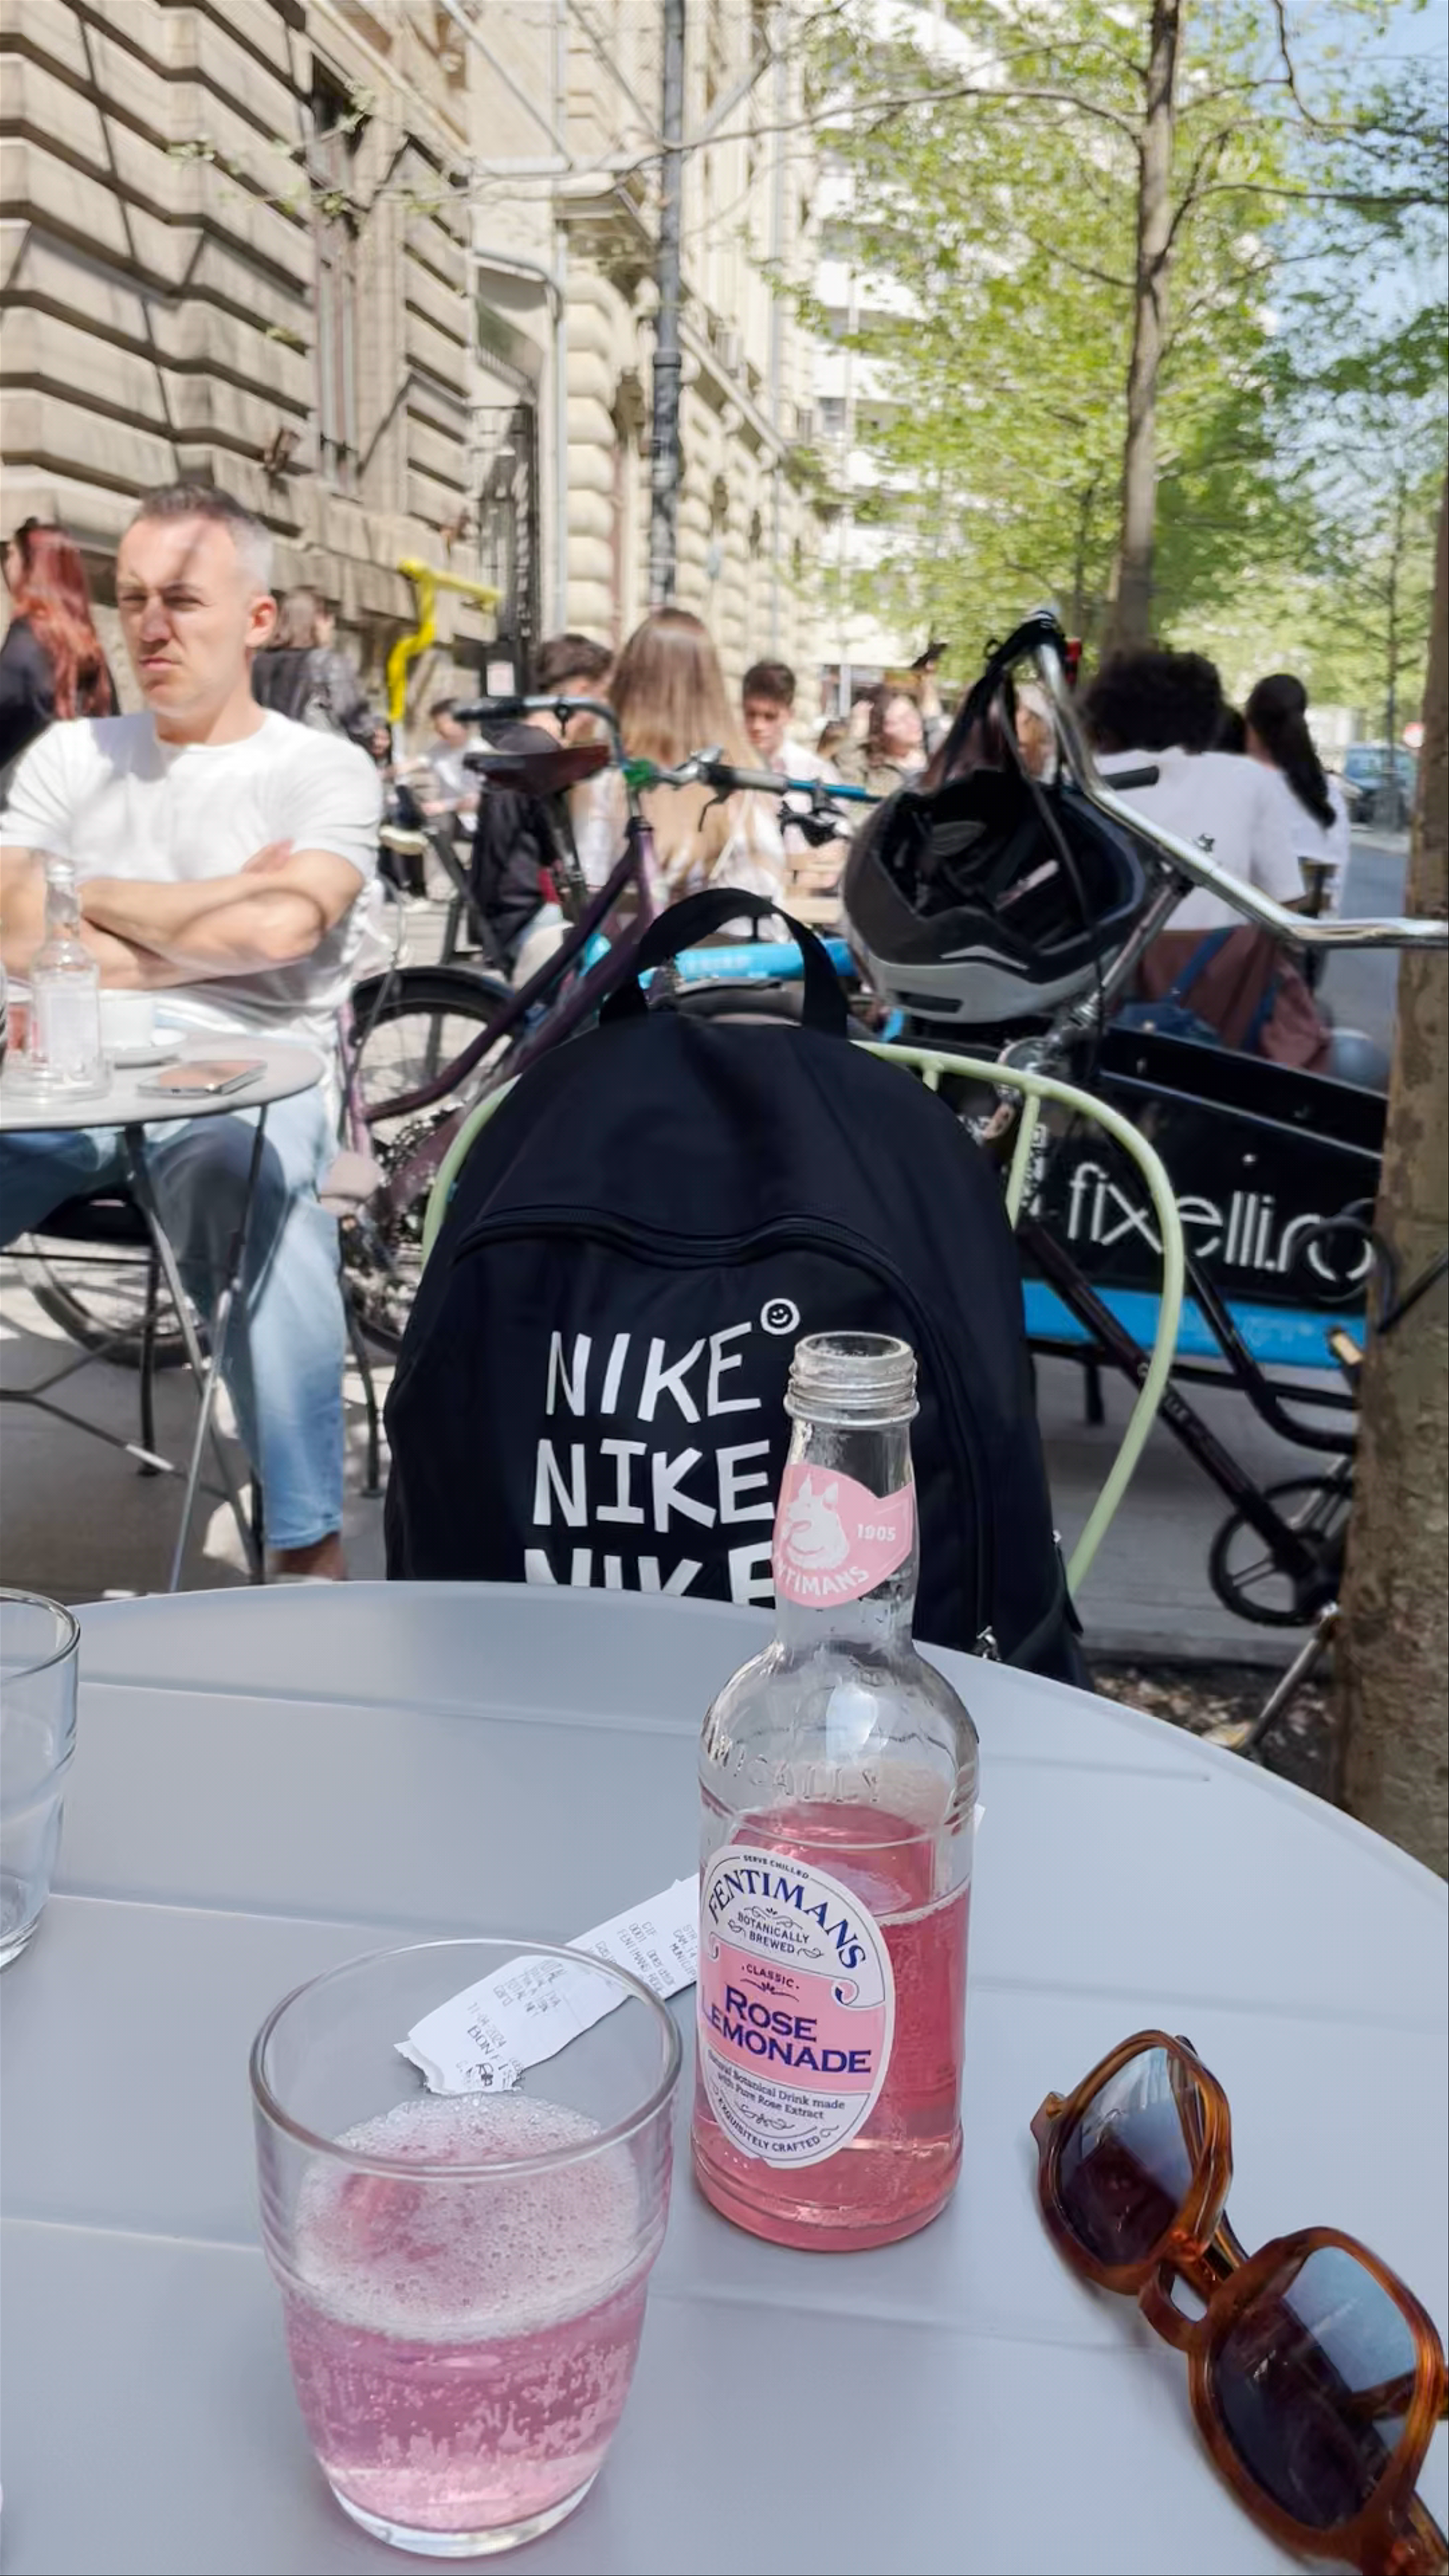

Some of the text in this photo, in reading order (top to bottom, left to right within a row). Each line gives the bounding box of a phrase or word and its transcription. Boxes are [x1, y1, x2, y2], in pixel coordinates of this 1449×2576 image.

[1067, 1162, 1374, 1281] fixelli.ro
[546, 1321, 761, 1423] NIKE
[533, 1438, 775, 1533] NIKE
[857, 1523, 896, 1541] 1905
[743, 1855, 809, 1879] SERVE CHILLED
[709, 1869, 866, 1969] FENTIMANS
[738, 1912, 810, 1944] BOTANICALLY
[749, 1931, 795, 1953] BREWED
[746, 1964, 794, 1987] CLASSIC
[725, 1984, 817, 2042] ROSE
[758, 2095, 782, 2110] Rose
[785, 2105, 824, 2119] Extract
[778, 2090, 809, 2106] Drink
[813, 2098, 845, 2110] made
[772, 2136, 820, 2152] CRAFTED
